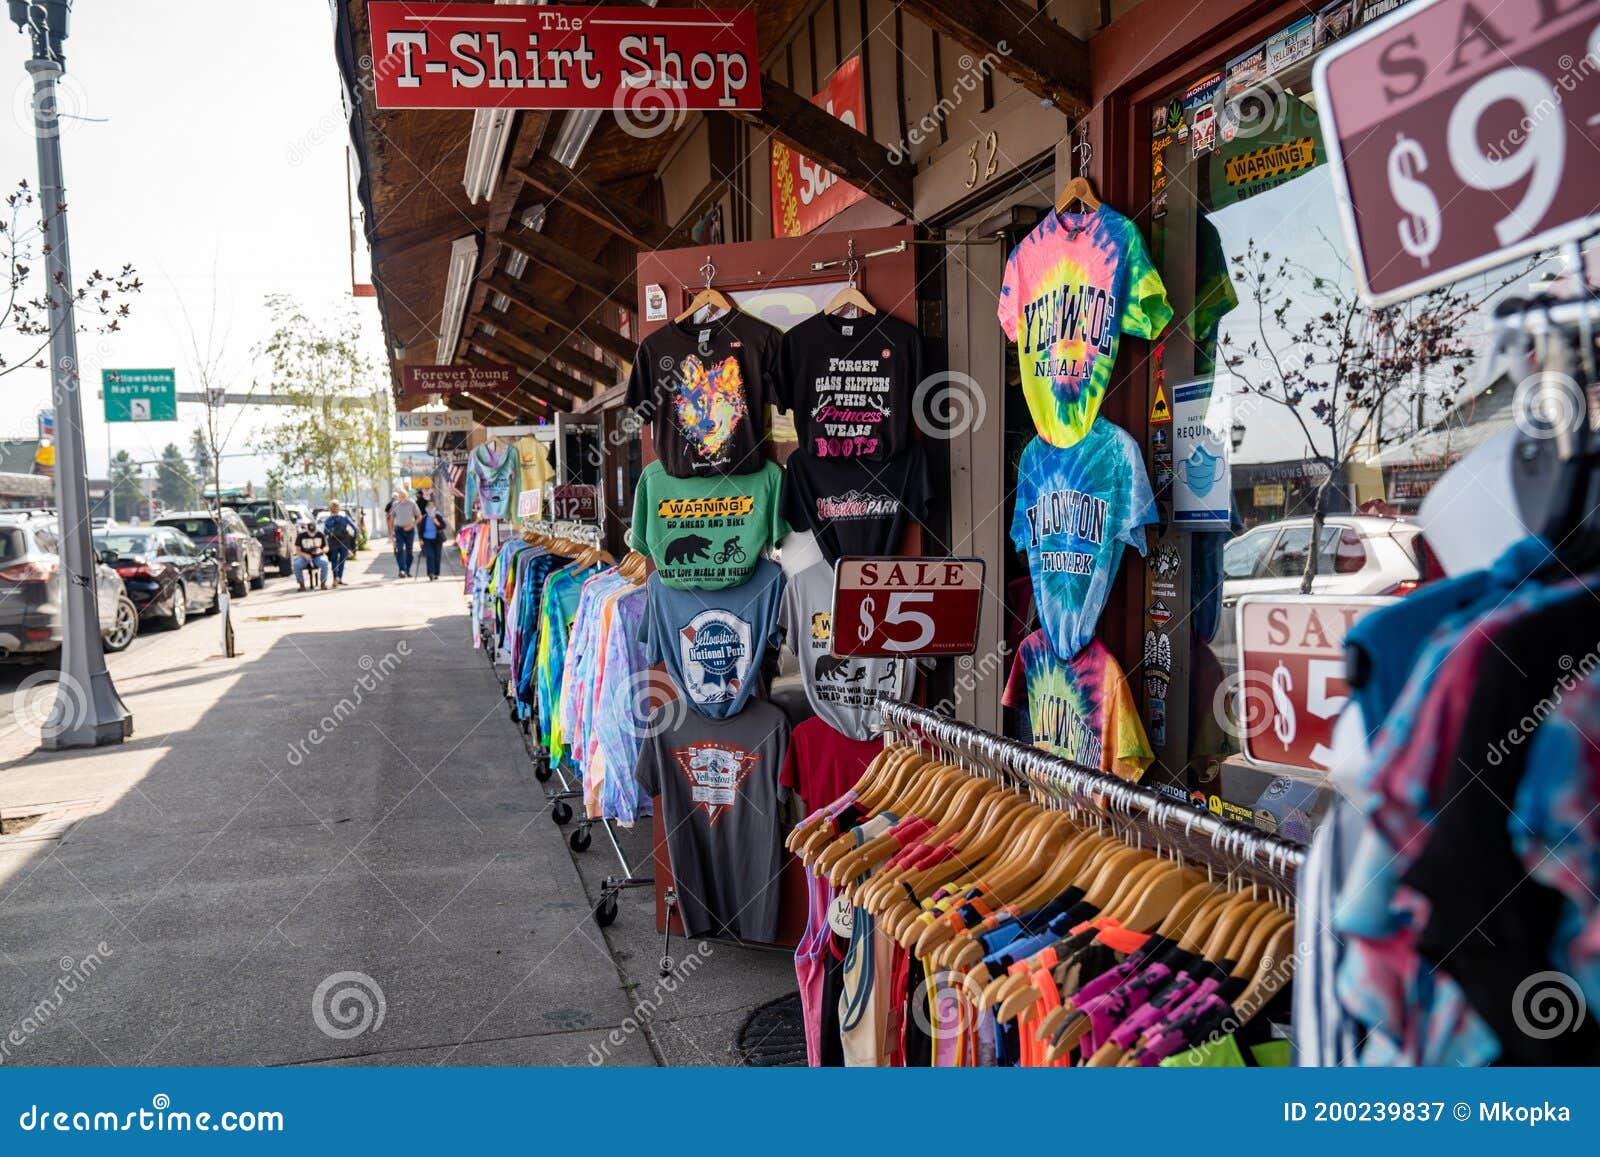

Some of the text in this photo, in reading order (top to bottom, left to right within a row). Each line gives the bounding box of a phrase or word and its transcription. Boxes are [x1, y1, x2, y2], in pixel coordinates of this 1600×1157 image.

[539, 12, 583, 31] The
[386, 32, 748, 107] T-Shirt Shop
[1186, 75, 1221, 99] MONTANA
[1234, 147, 1304, 177] WARNING!
[413, 367, 509, 381] Forever Young
[142, 384, 167, 393] Park
[844, 377, 890, 392] SLIPPERS
[834, 394, 867, 407] THIS
[399, 414, 469, 428] Kids Shop
[816, 406, 882, 423] Princess
[824, 424, 872, 437] WEARS
[815, 436, 879, 457] BOOTS
[670, 501, 743, 514] WARNING!
[867, 500, 900, 514] PARK
[667, 520, 677, 529] GO
[680, 519, 705, 529] AHEAD
[708, 519, 724, 528] AND
[677, 568, 692, 577] LOVE
[694, 567, 716, 577] MEALS
[860, 563, 964, 587] SALE
[857, 591, 936, 652] $5
[695, 630, 740, 651] Yellowstone
[690, 644, 745, 661] National Park
